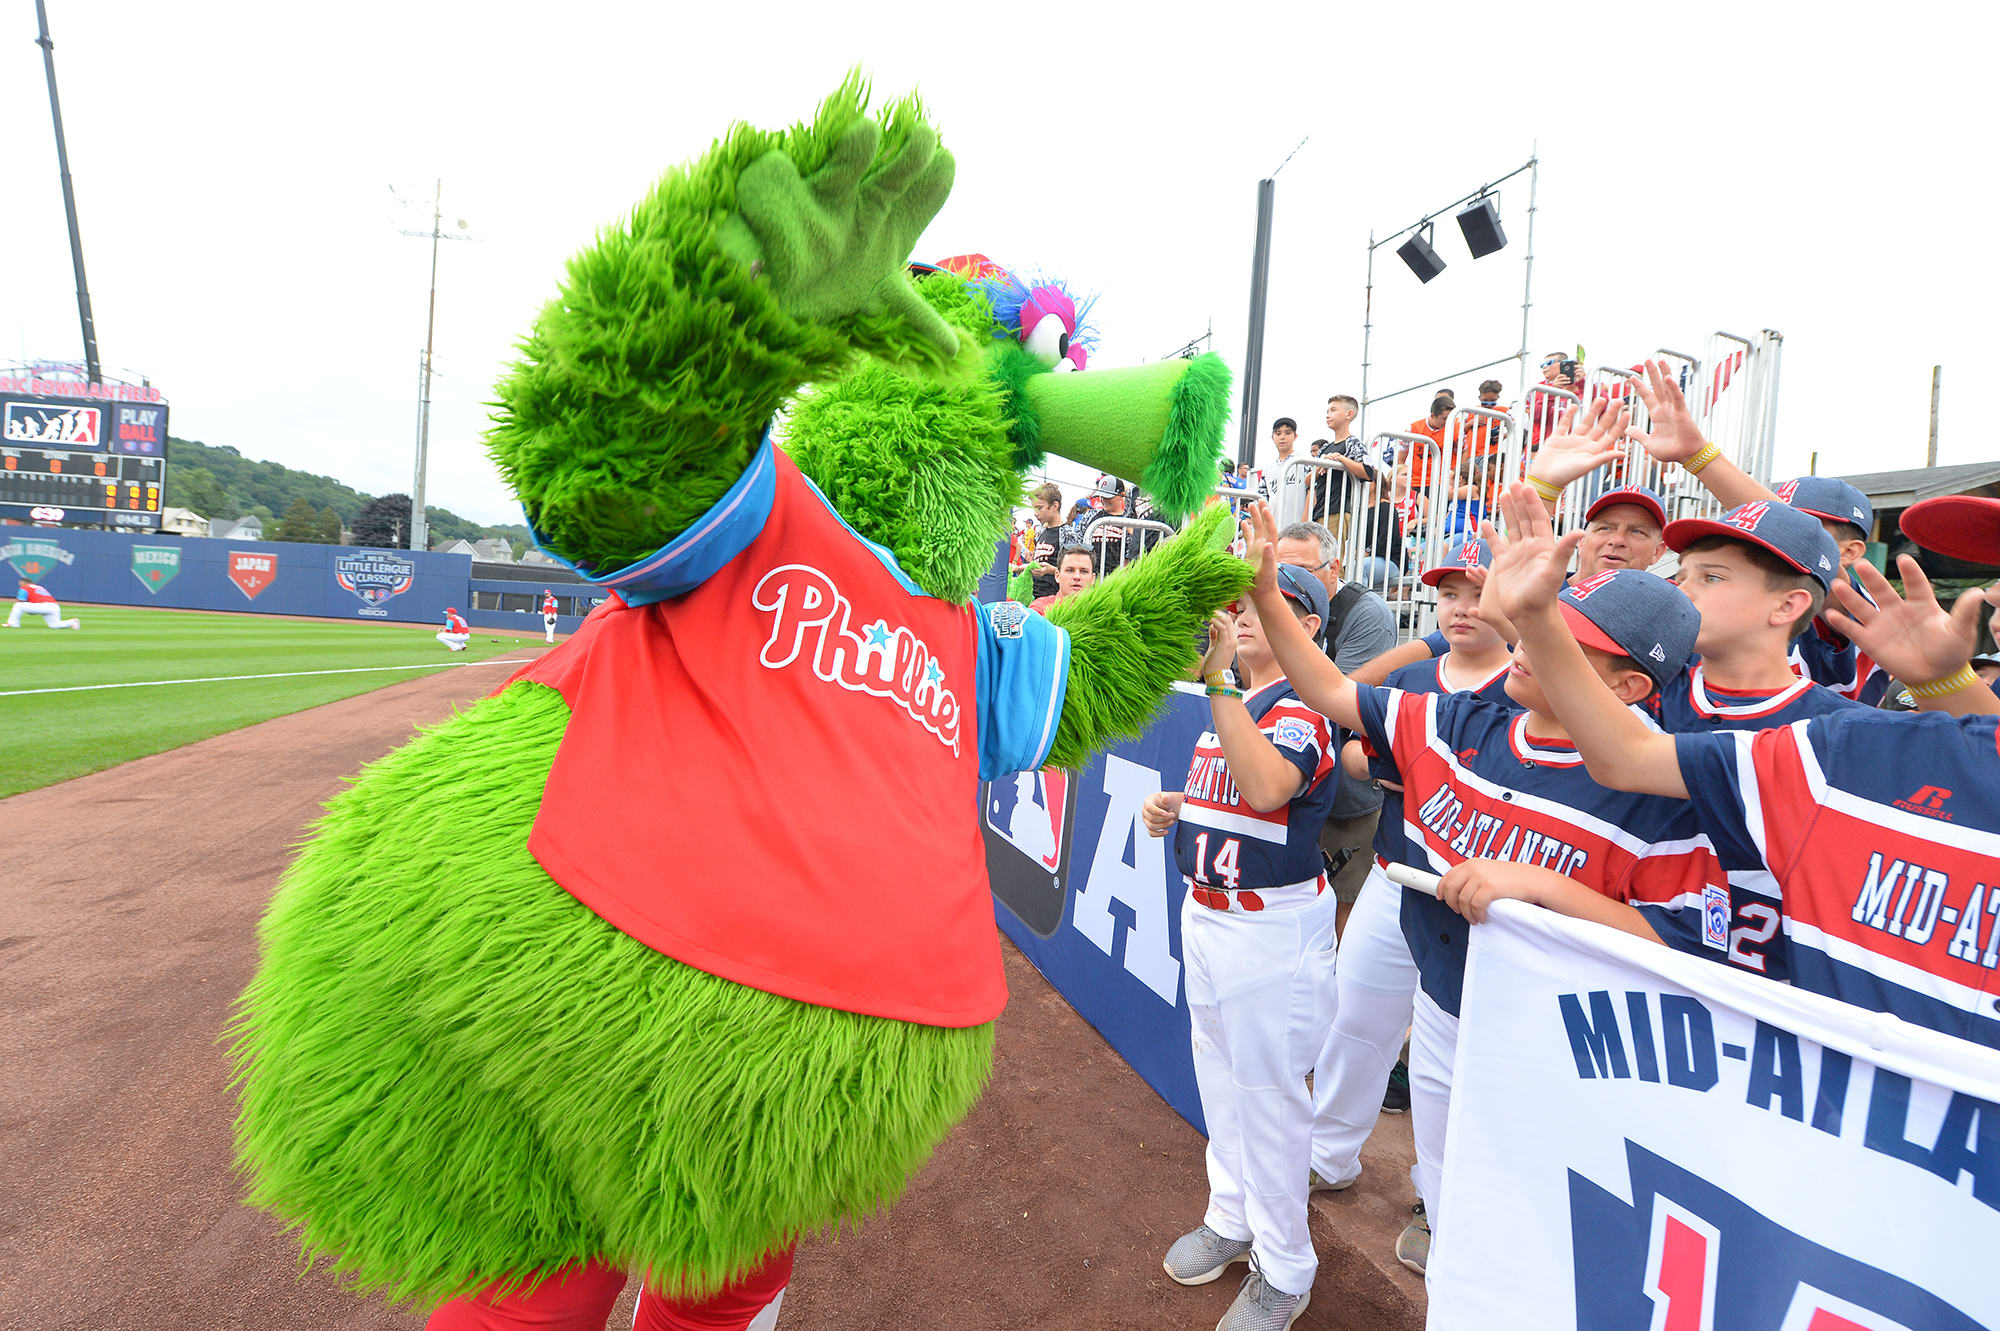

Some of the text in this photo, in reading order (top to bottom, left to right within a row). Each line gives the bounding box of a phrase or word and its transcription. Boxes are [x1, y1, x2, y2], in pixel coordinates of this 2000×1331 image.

[32, 380, 115, 399] BOWMAN
[119, 385, 161, 402] FIELD
[120, 408, 158, 426] PLAY
[119, 424, 157, 442] BALL
[135, 550, 179, 566] MEXICO
[1457, 541, 1481, 565] MA
[235, 557, 271, 572] JAPAN
[339, 561, 411, 575] LITTLE LEAGUE
[355, 573, 393, 585] CLASSIC
[358, 609, 388, 617] GEICO
[1892, 799, 1954, 822] RUSSELL
[1195, 832, 1241, 889] 14
